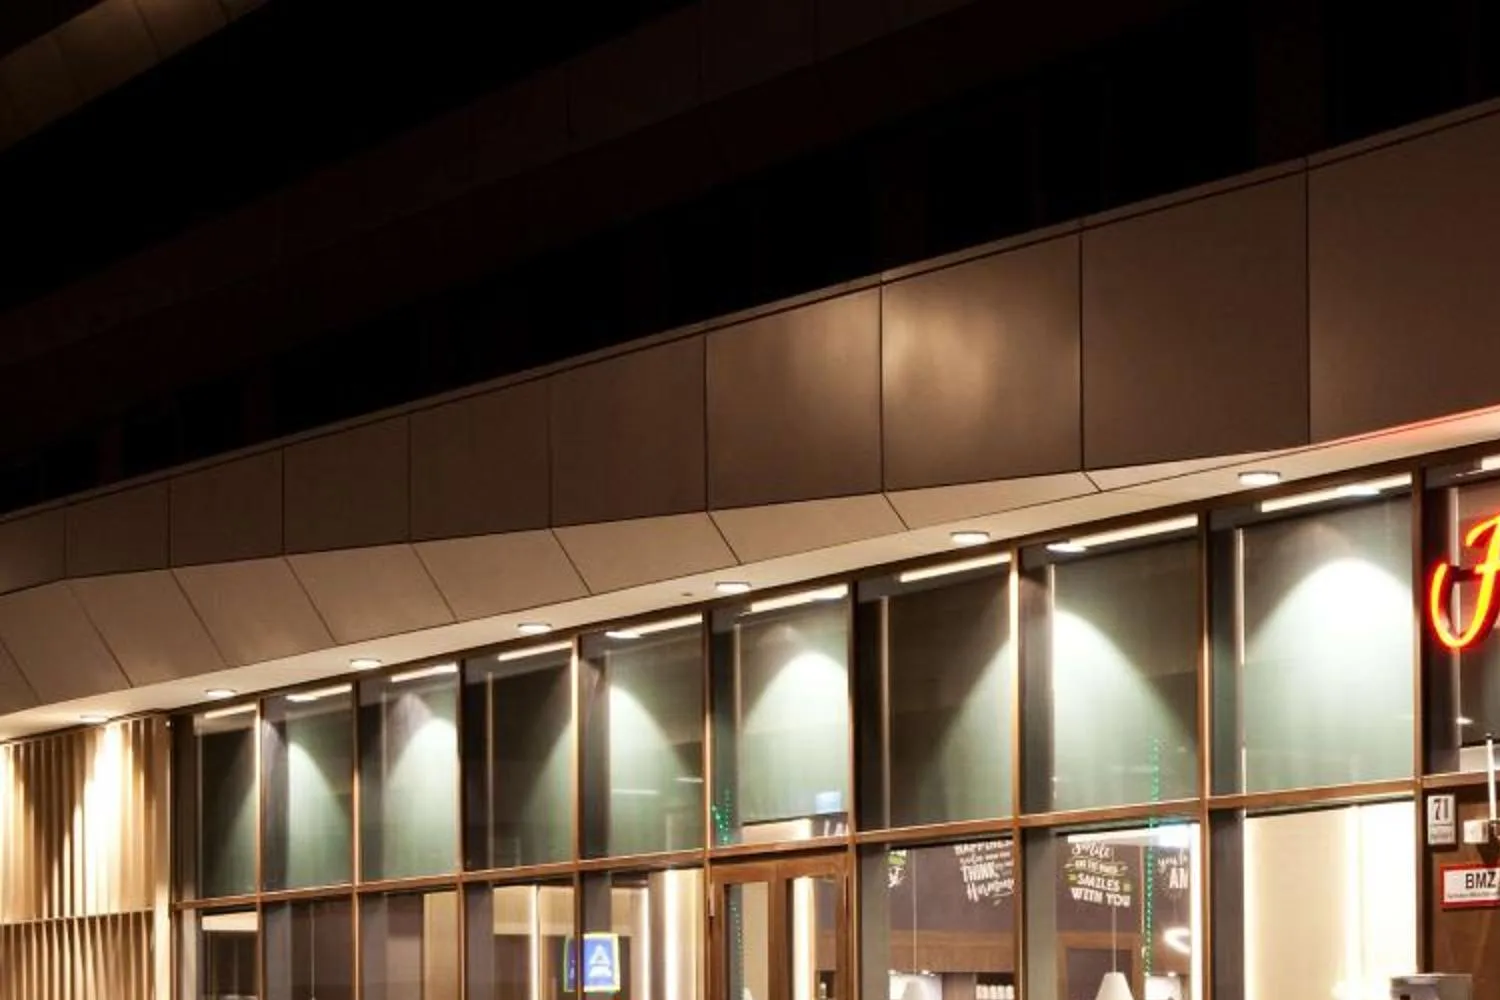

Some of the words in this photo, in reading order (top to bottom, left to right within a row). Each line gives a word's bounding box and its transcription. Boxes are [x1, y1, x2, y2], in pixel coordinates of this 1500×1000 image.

[1077, 873, 1121, 893] SMILES
[1465, 871, 1497, 890] BMZ
[1071, 887, 1104, 904] WITH
